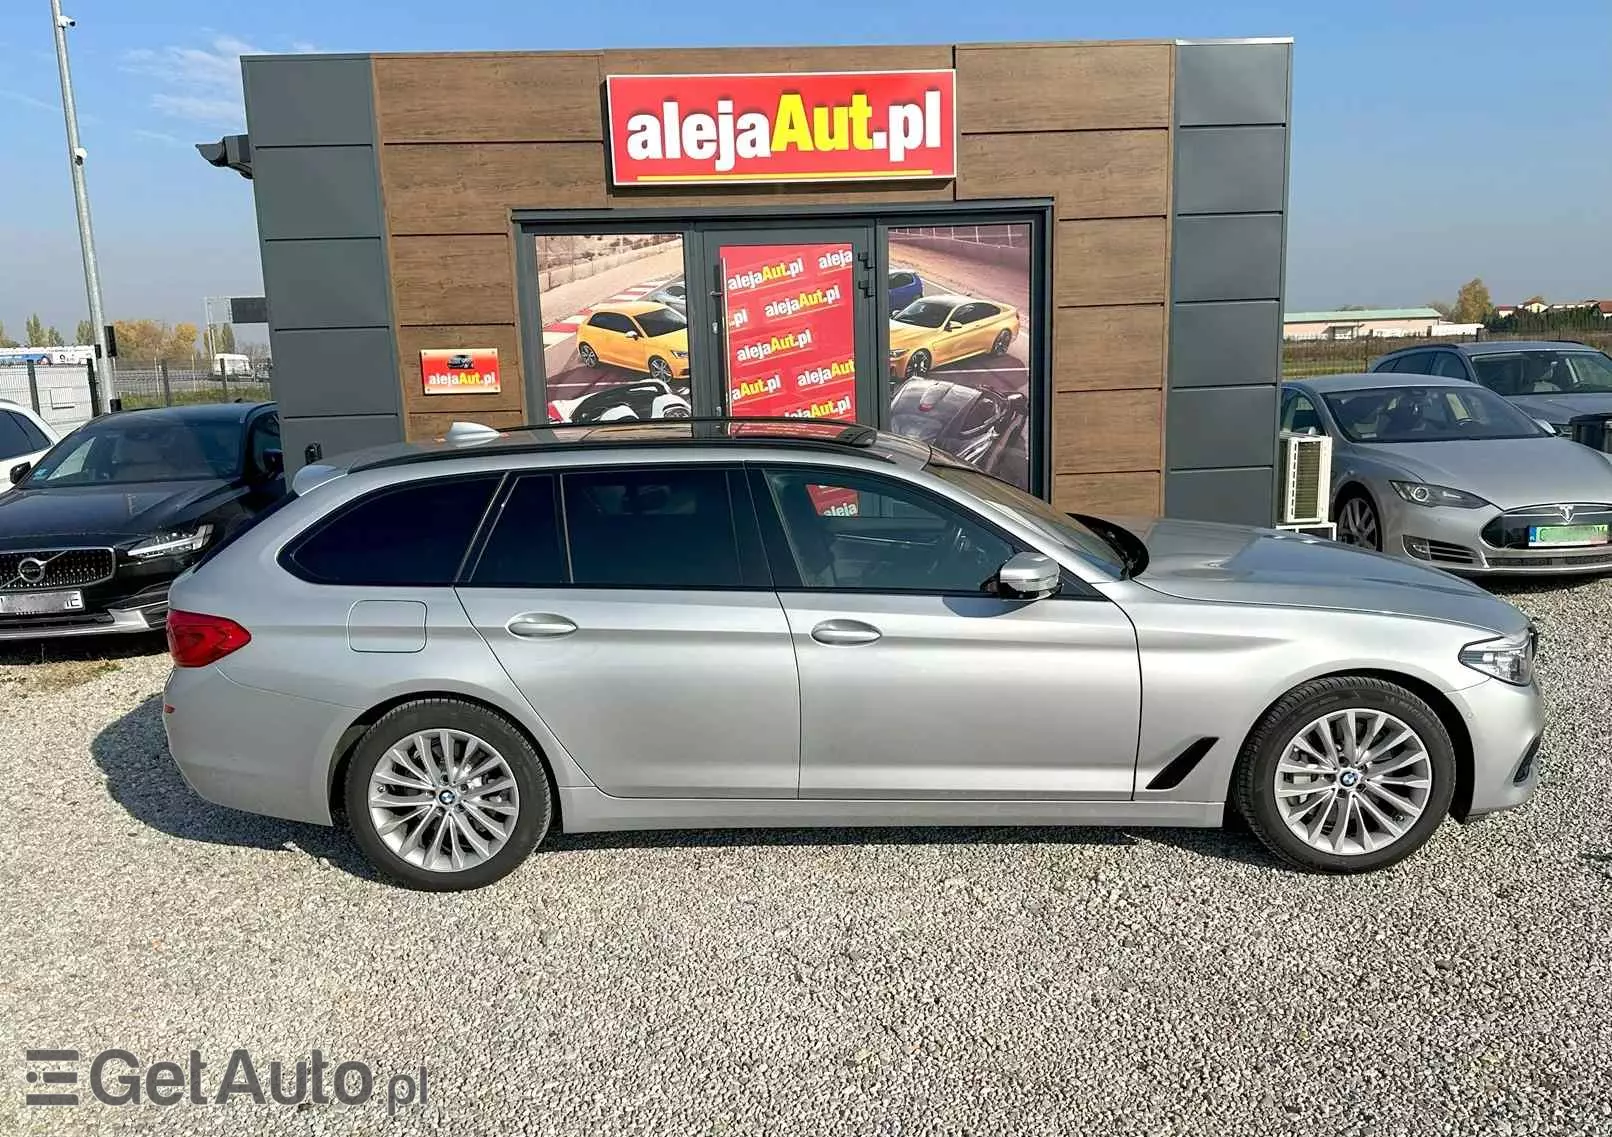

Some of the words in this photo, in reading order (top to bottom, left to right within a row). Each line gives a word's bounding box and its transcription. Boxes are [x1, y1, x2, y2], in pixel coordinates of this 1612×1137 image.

[626, 89, 942, 172] alejaAut.pl
[727, 257, 804, 290] alejaAut.pl
[818, 249, 853, 269] aleja
[764, 285, 840, 317] alejaAut.pl
[736, 329, 812, 361] alejaAut.pl
[428, 371, 496, 387] alejaAut.pl
[784, 396, 851, 418] jaAut.pl
